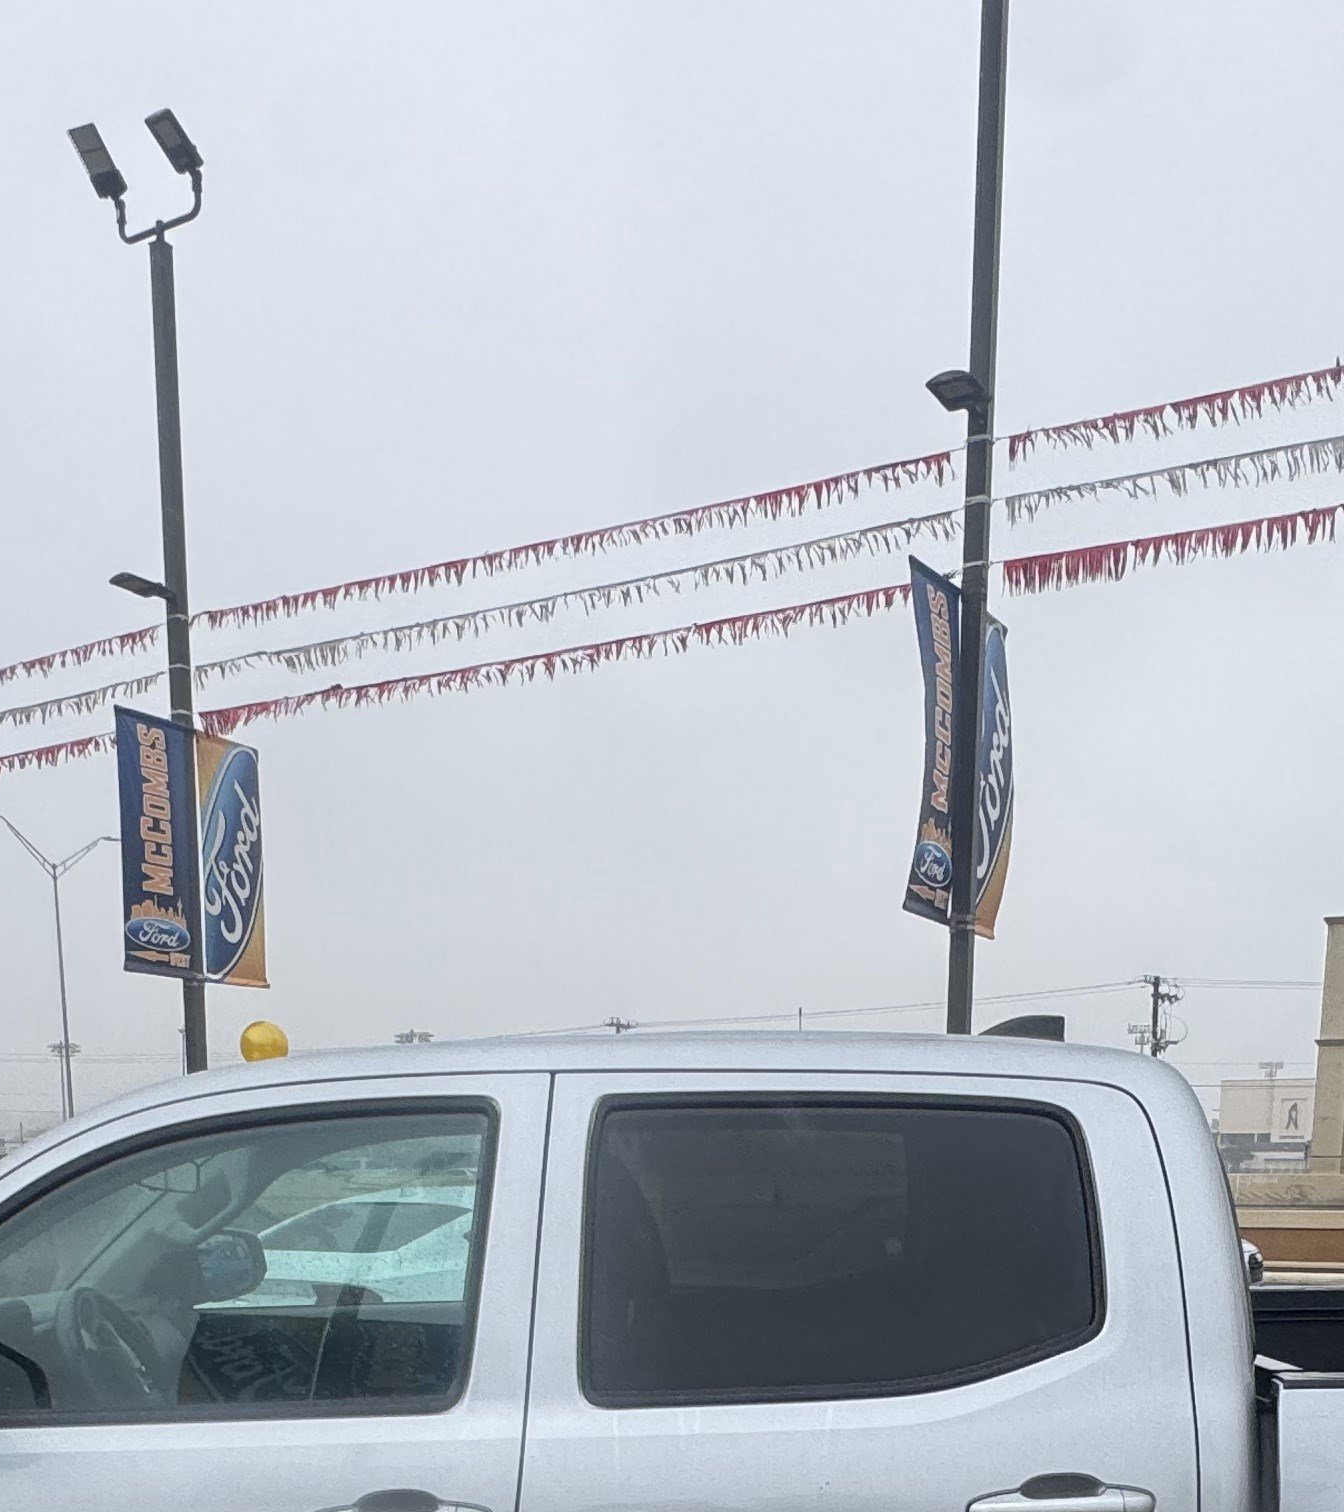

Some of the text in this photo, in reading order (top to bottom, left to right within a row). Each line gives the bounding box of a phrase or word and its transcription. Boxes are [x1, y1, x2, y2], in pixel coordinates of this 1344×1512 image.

[926, 583, 954, 815] MCCOMBS
[137, 722, 174, 896] MCCOMBS
[205, 779, 260, 944] Ford
[920, 845, 947, 882] Ford
[139, 920, 180, 949] Ford
